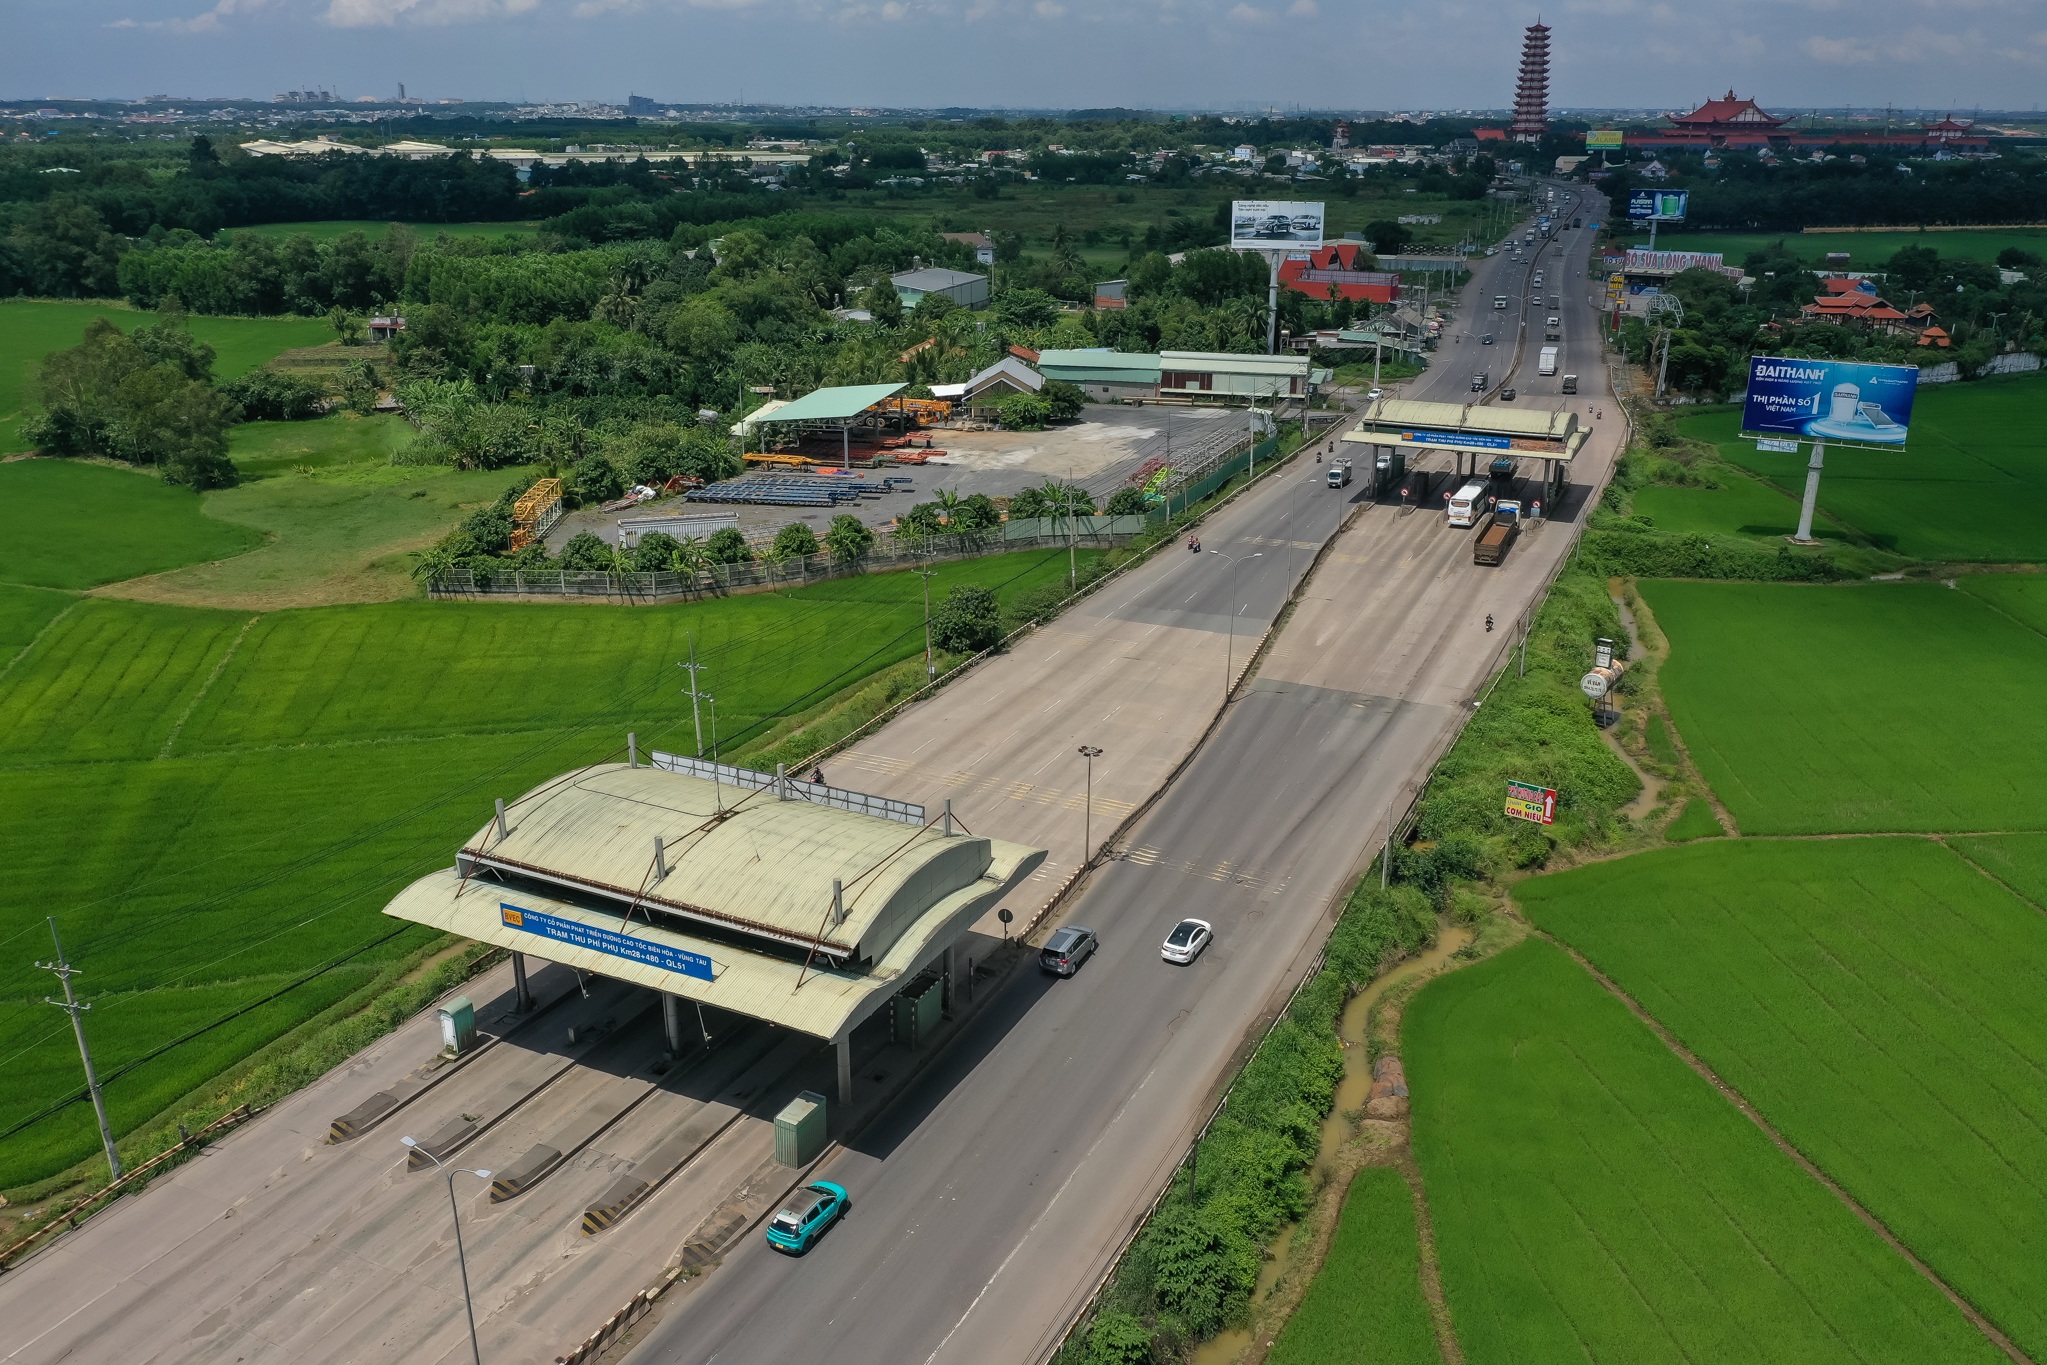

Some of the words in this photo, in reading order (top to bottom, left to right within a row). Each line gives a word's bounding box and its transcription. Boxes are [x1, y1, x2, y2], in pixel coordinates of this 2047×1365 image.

[1752, 394, 1768, 404] THỊ
[1769, 394, 1796, 406] PHẦN
[1797, 396, 1812, 406] SỐ
[1811, 391, 1822, 415] 1
[1765, 404, 1780, 412] VIỆT
[504, 911, 521, 925] BVEC
[523, 912, 540, 922] CÔNG
[539, 916, 547, 924] TY
[622, 938, 634, 947] CAO
[634, 941, 647, 950] TỐC
[647, 945, 661, 954] BIÊN
[661, 949, 674, 958] HÒA
[677, 953, 694, 963] VŨNG
[695, 957, 707, 966] TÀU
[545, 926, 569, 939] TRẠM
[569, 933, 586, 944] THU
[587, 937, 601, 948] PHÍ
[601, 941, 619, 954] PHỤ
[620, 946, 660, 964] Km28+480
[665, 958, 686, 971] QL51
